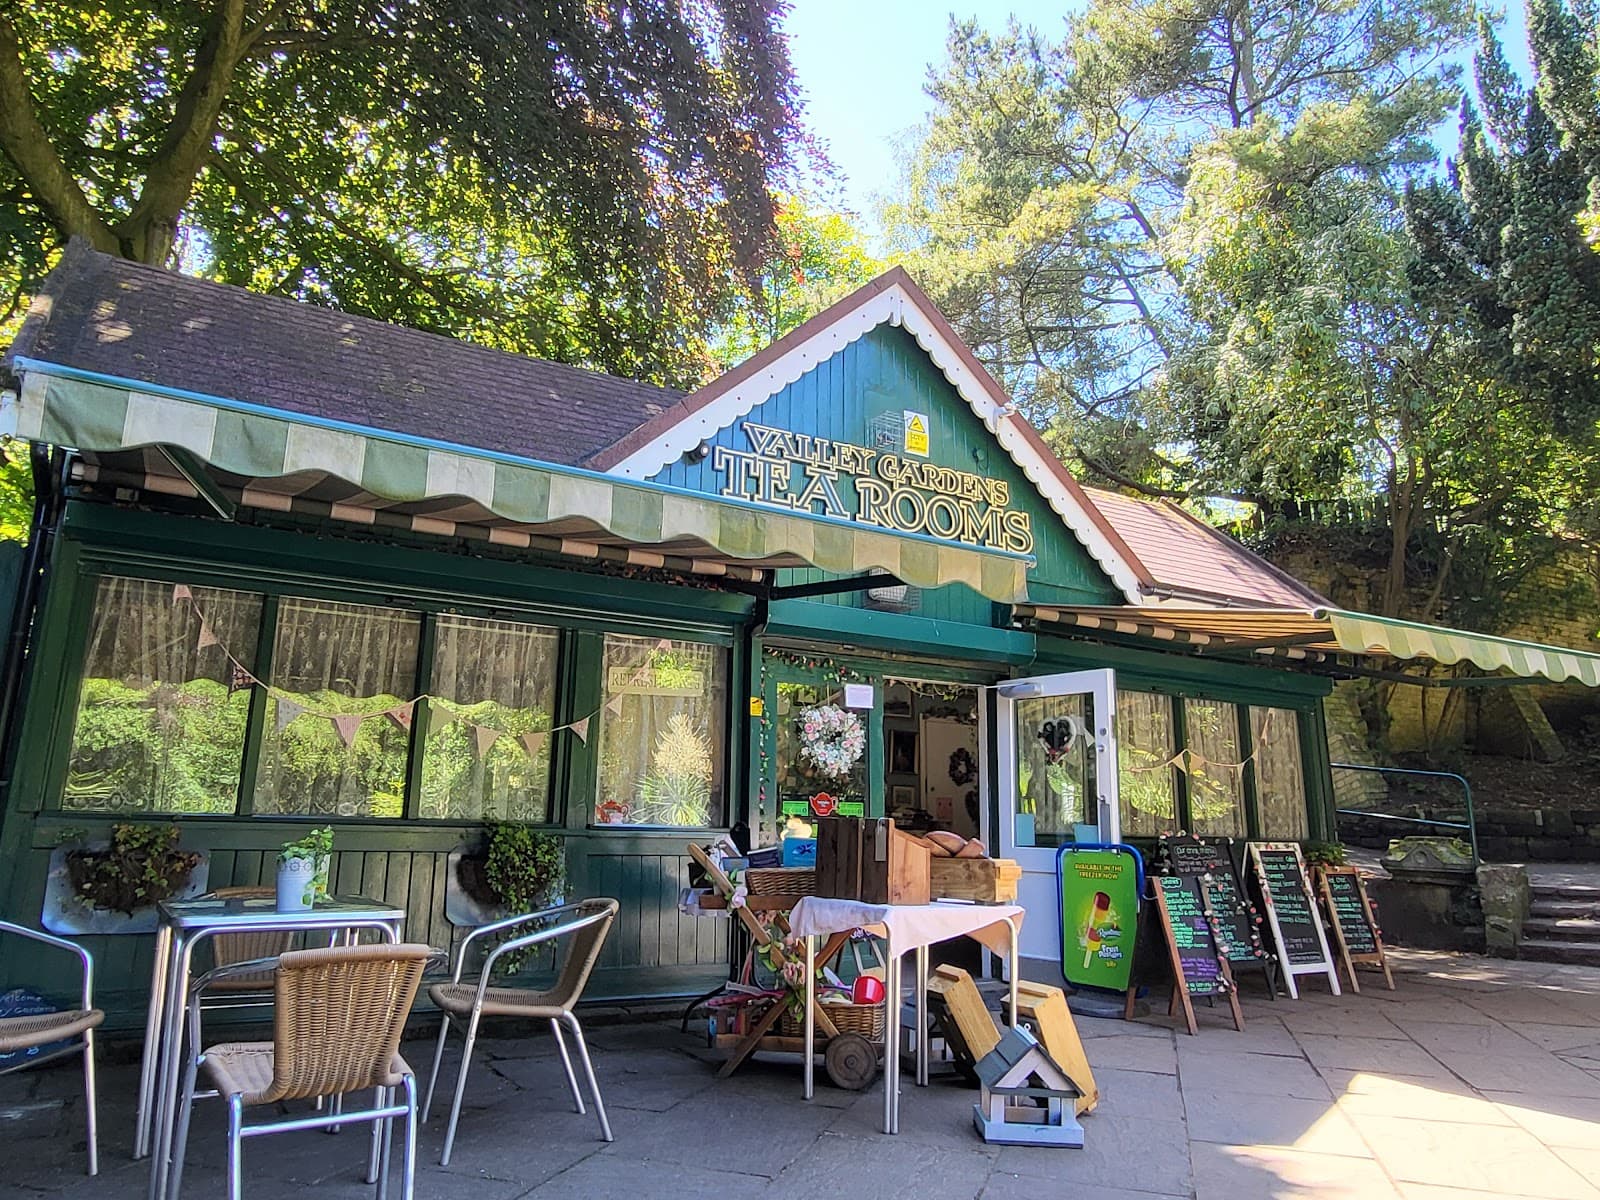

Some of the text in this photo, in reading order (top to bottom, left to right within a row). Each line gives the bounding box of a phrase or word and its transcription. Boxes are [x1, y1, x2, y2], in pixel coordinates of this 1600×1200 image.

[742, 421, 1010, 507] VALLEY GARDENS
[713, 446, 1034, 554] TEA ROOMS
[1074, 863, 1102, 871] AVAILABLE
[1079, 871, 1118, 880] FREEZER NOW
